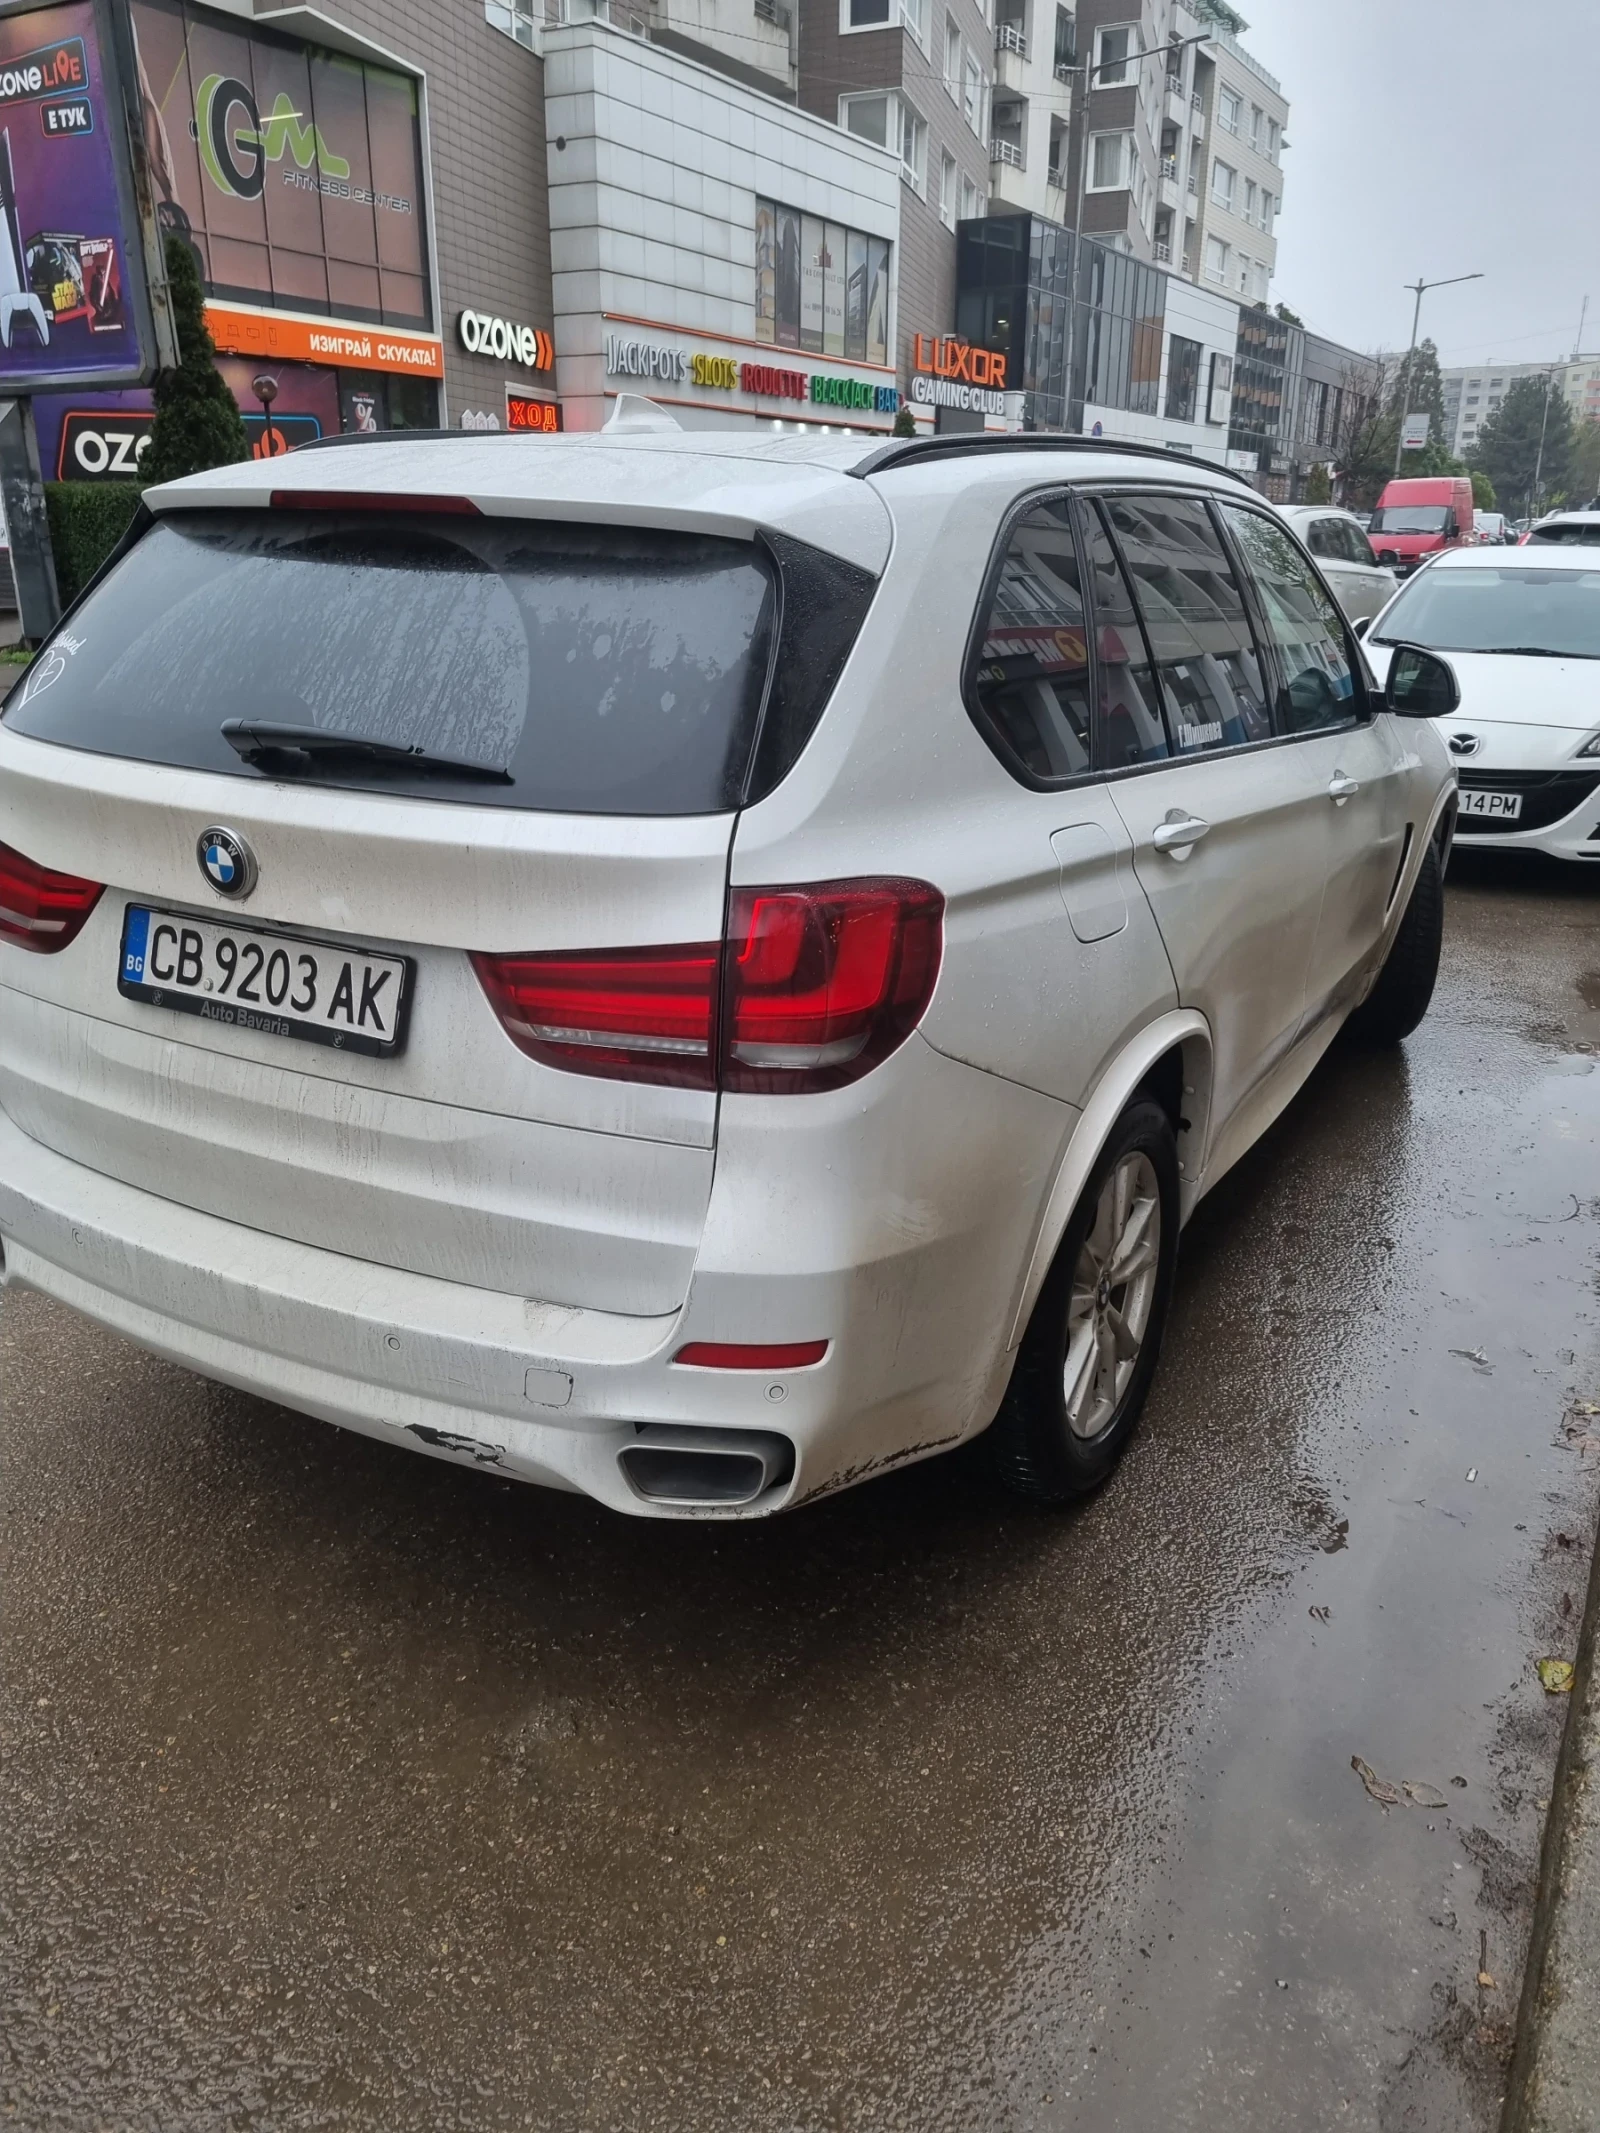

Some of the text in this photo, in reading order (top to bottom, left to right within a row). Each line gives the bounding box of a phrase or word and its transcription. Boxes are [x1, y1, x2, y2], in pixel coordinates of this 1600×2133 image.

[58, 106, 87, 128] ТУК
[284, 170, 412, 214] FITNESS CENTER
[309, 333, 436, 366] ИЗИГРАЙ СКУКАТА!
[914, 333, 1005, 388] LUXOR
[607, 335, 687, 382] JACKPOTS
[691, 353, 737, 389] SLOTS
[741, 363, 808, 400] ROULETTE
[874, 386, 898, 412] BAR
[912, 377, 1004, 414] GAMING CLUB
[508, 401, 557, 432] ХОД
[1488, 795, 1517, 815] PM
[201, 835, 238, 857] BMW
[126, 954, 143, 973] BG
[150, 924, 392, 1031] CB 9203 AK
[200, 1001, 290, 1036] Auto Bavaria
